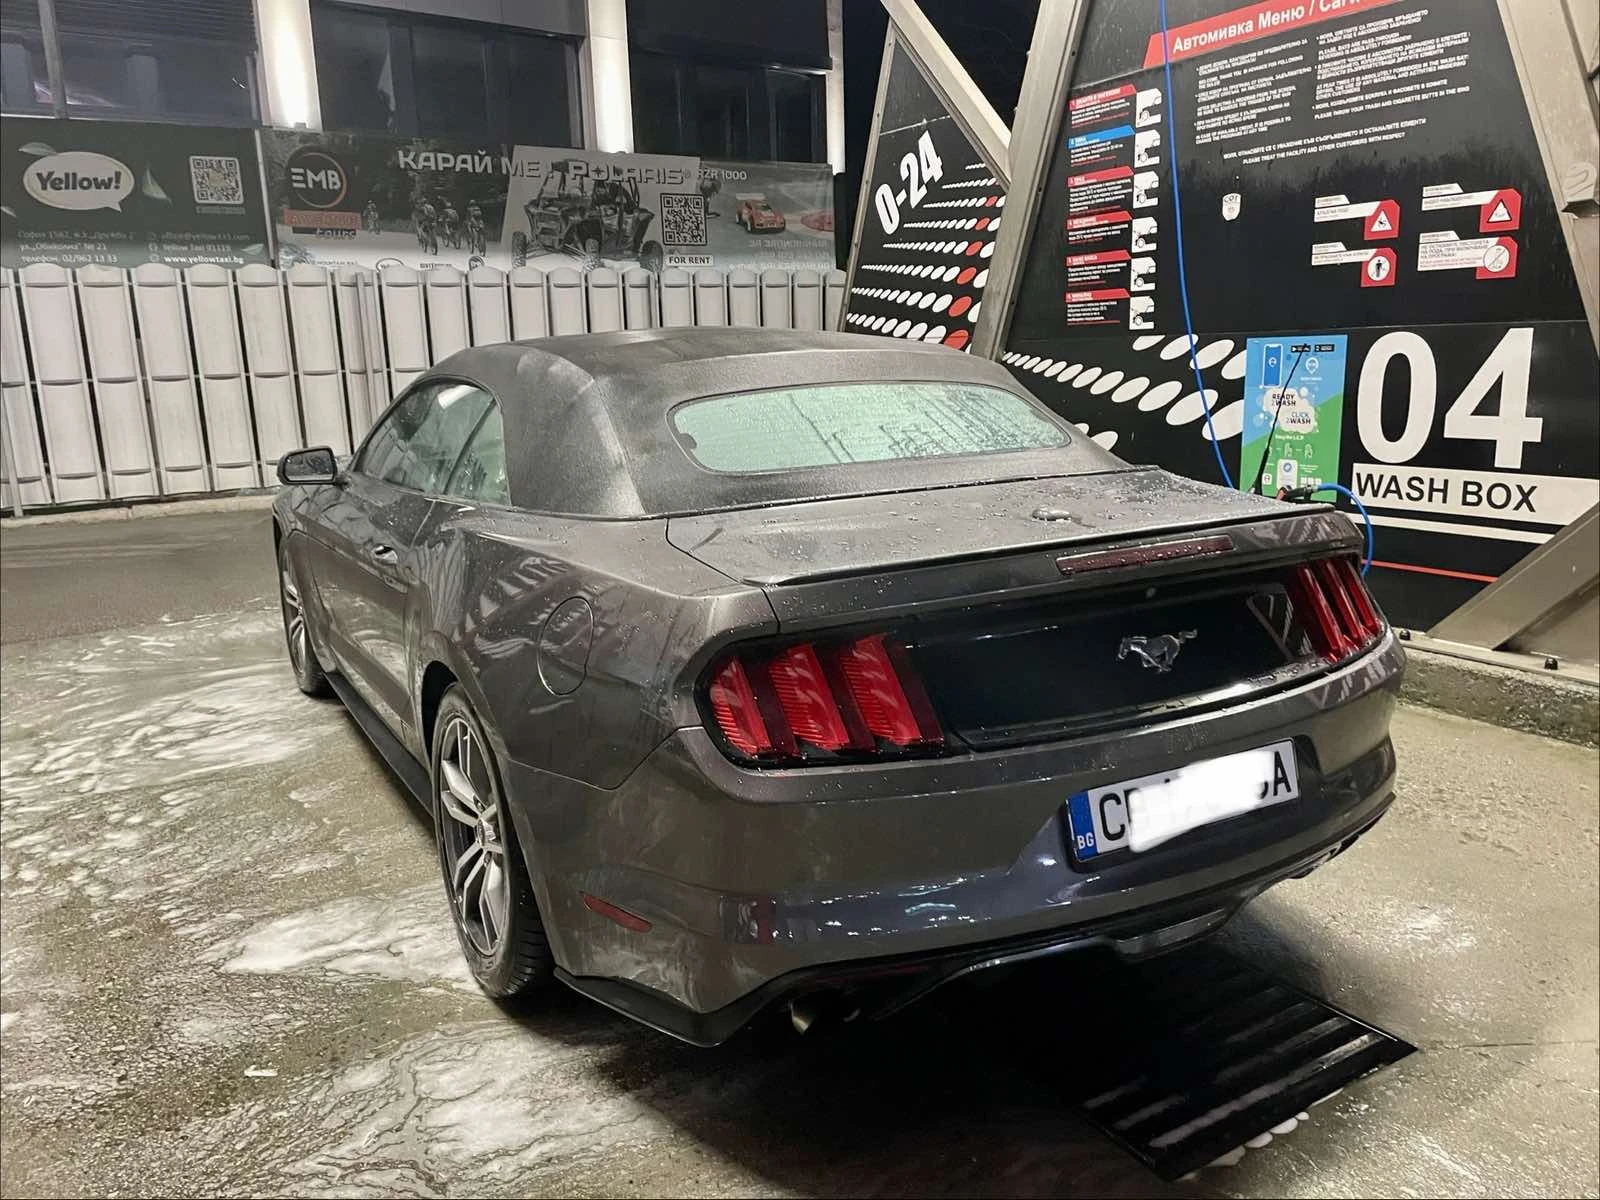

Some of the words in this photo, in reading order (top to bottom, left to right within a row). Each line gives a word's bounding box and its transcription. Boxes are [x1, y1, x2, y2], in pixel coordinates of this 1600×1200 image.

[1173, 23, 1253, 53] Автомивка
[1258, 6, 1304, 30] Меню
[398, 150, 493, 174] КАРАЙ
[36, 170, 122, 191] Yellow!
[290, 167, 341, 190] EMB
[875, 130, 943, 234] 0-24
[669, 256, 686, 264] FOR
[689, 256, 711, 264] RENT
[1357, 327, 1543, 469] 04
[1356, 472, 1449, 504] WASH
[1460, 480, 1538, 513] BOX
[1077, 833, 1095, 850] BG
